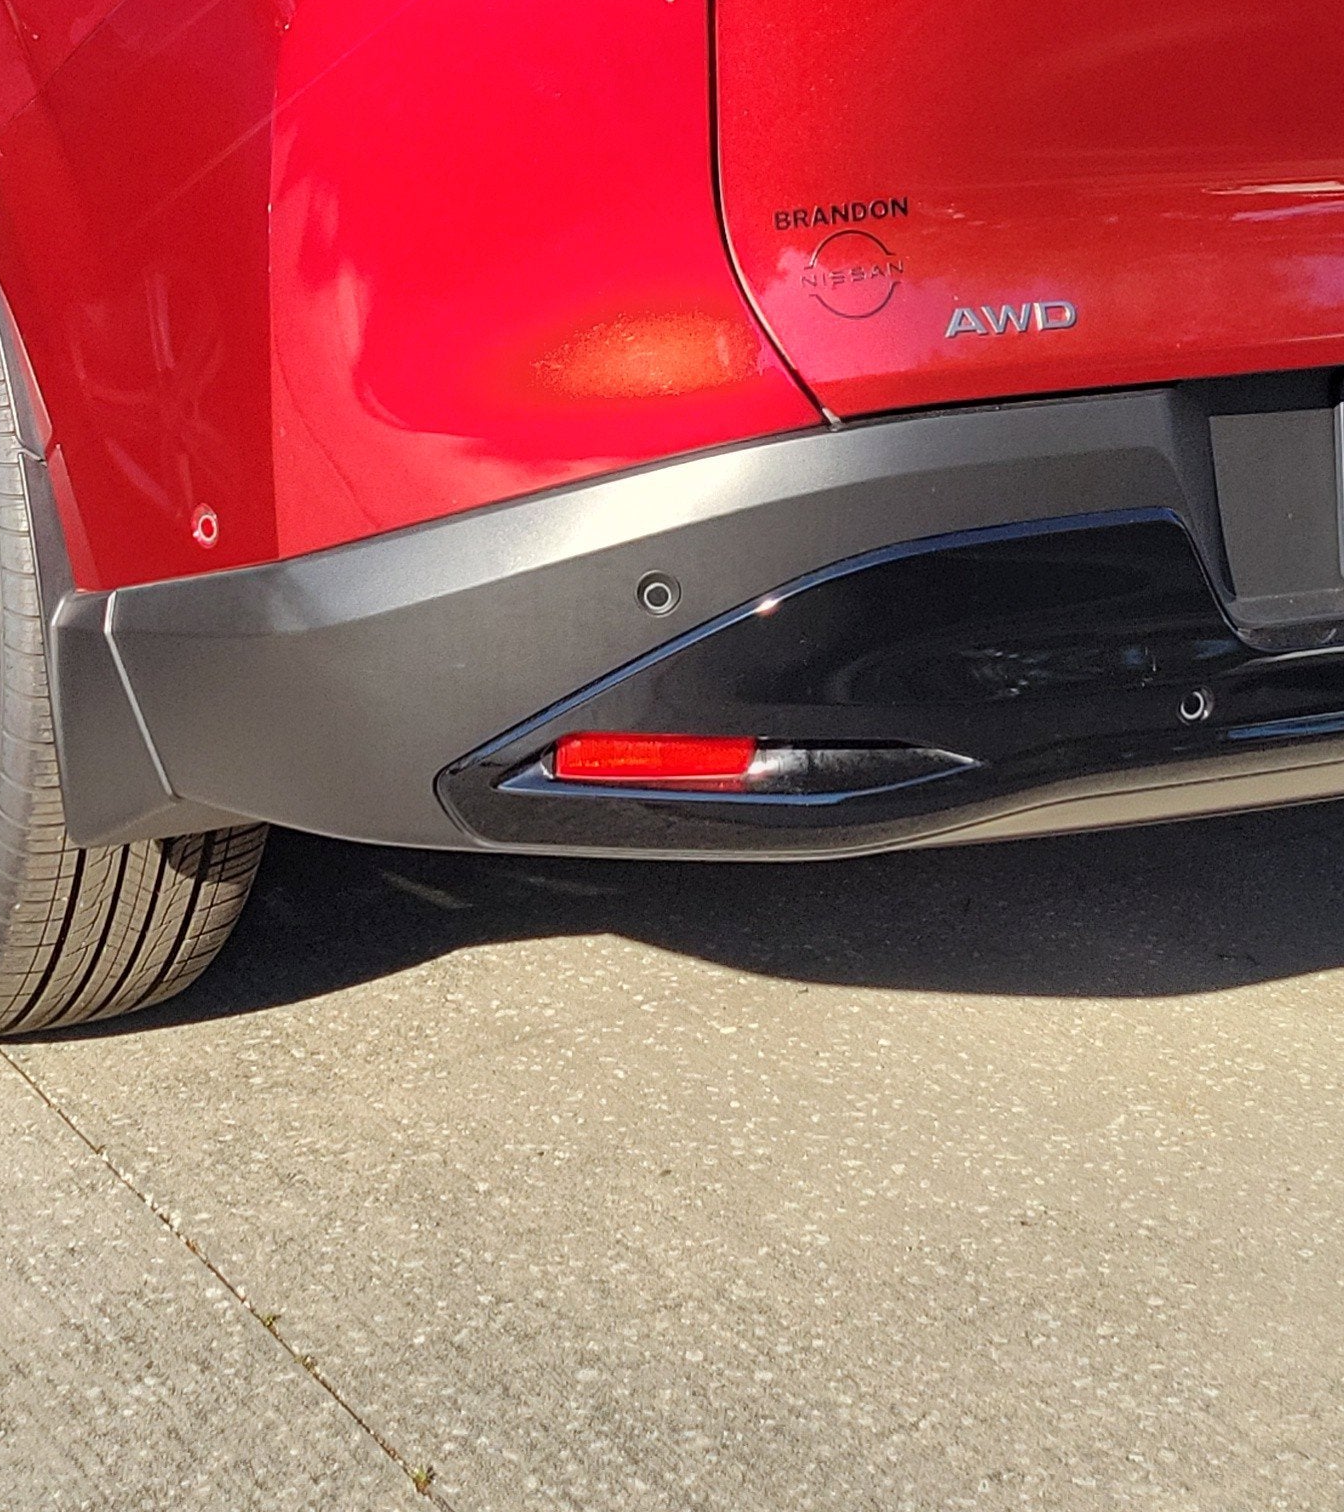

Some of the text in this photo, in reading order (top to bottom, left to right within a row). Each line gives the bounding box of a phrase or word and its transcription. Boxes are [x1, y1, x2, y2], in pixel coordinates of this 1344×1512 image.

[773, 196, 909, 230] BRANDON
[801, 259, 905, 289] NISSAN
[944, 300, 1078, 339] AWD
